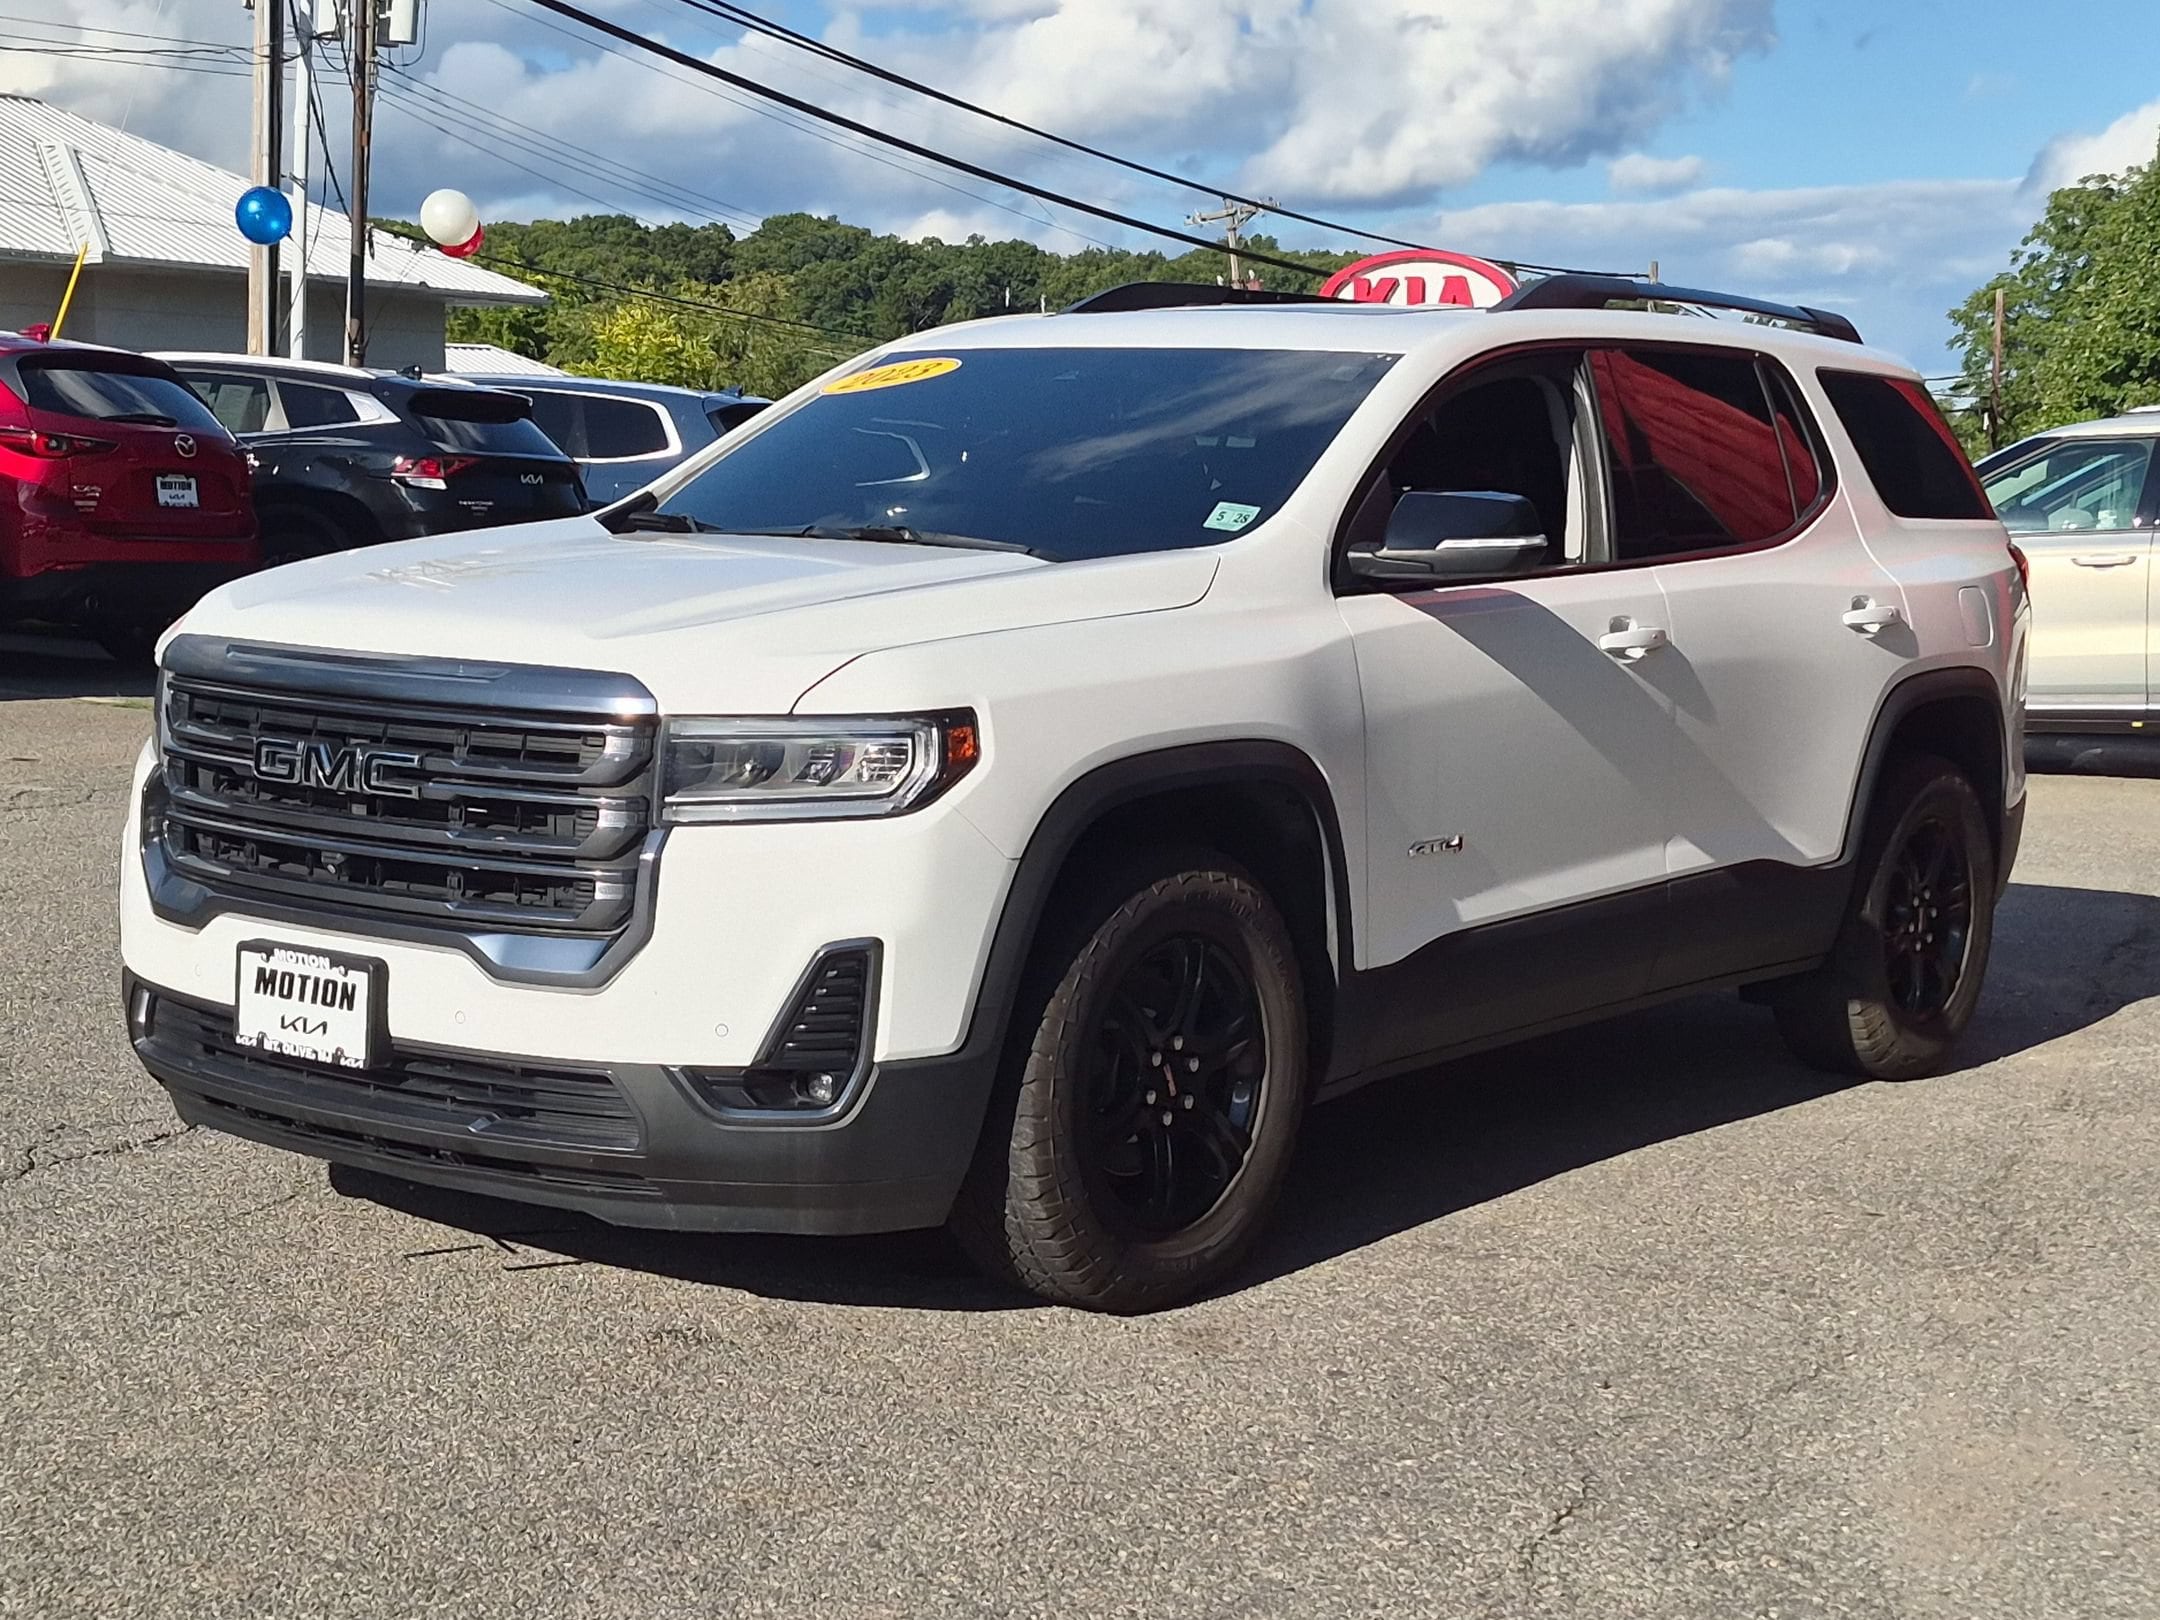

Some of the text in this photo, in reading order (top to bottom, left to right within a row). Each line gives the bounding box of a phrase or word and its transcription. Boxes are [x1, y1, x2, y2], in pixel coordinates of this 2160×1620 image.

[1353, 275, 1474, 307] KIA
[520, 474, 544, 485] KIA
[1216, 510, 1251, 524] 5 28
[254, 736, 422, 801] GMC
[273, 949, 330, 970] MOTION
[254, 966, 357, 1012] MOTION
[280, 1013, 328, 1037] KIA
